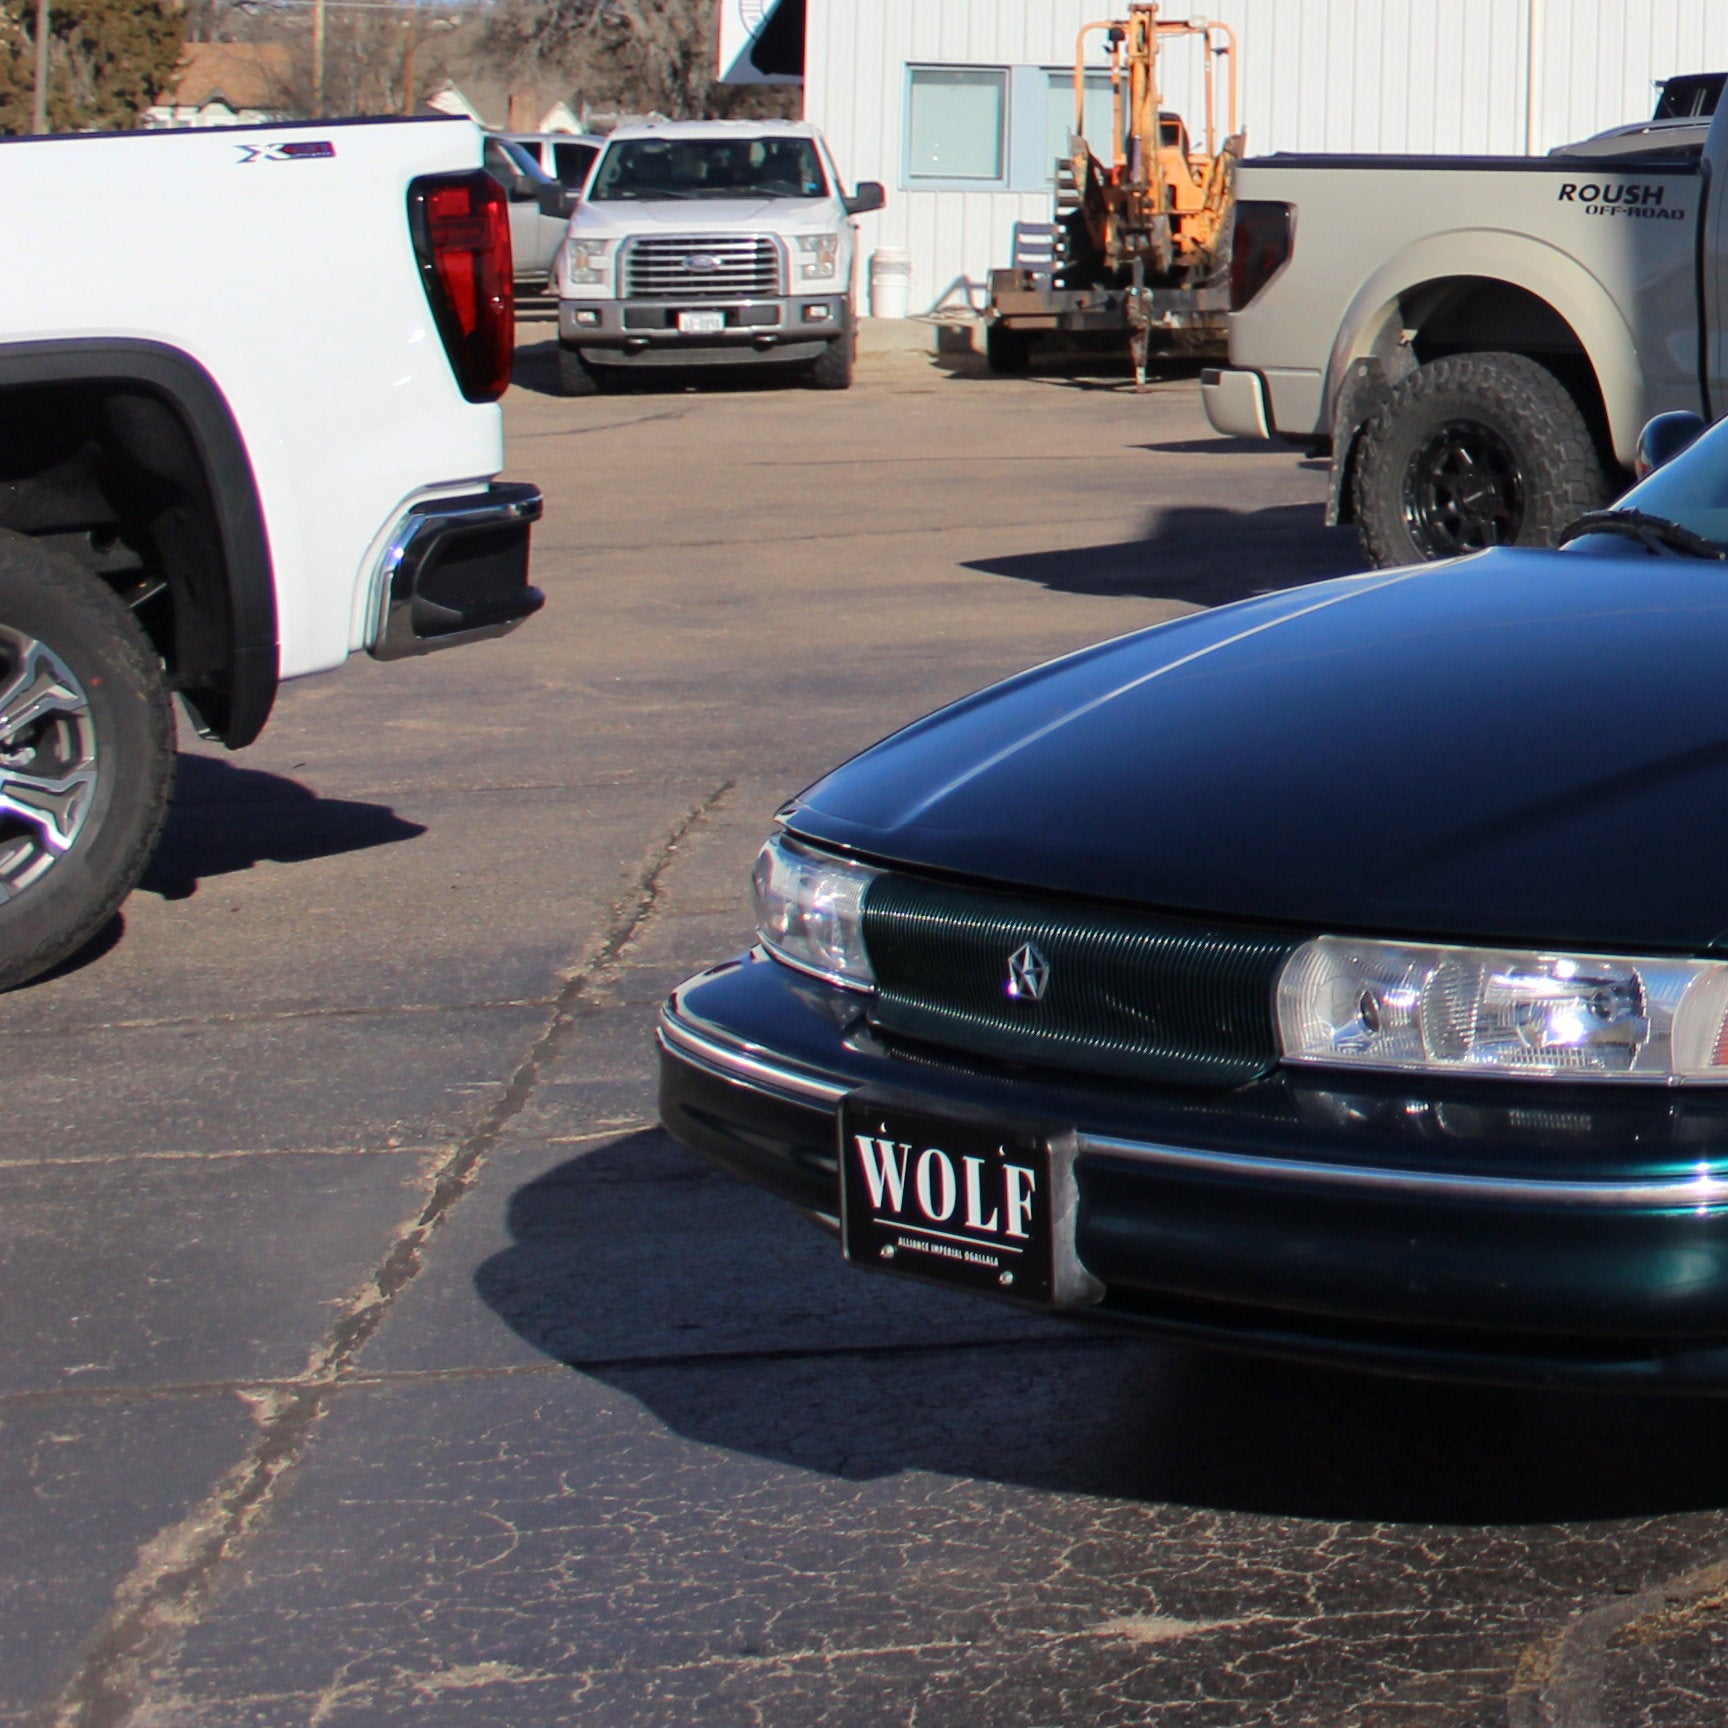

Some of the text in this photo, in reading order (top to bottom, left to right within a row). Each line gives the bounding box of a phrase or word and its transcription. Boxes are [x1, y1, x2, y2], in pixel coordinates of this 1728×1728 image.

[1558, 183, 1665, 206] ROUSH
[1584, 204, 1686, 221] OFF-ROAD
[853, 1134, 1037, 1240] WOLF
[897, 1236, 999, 1268] ALLIANCE IMPERIAL OGALLALA
